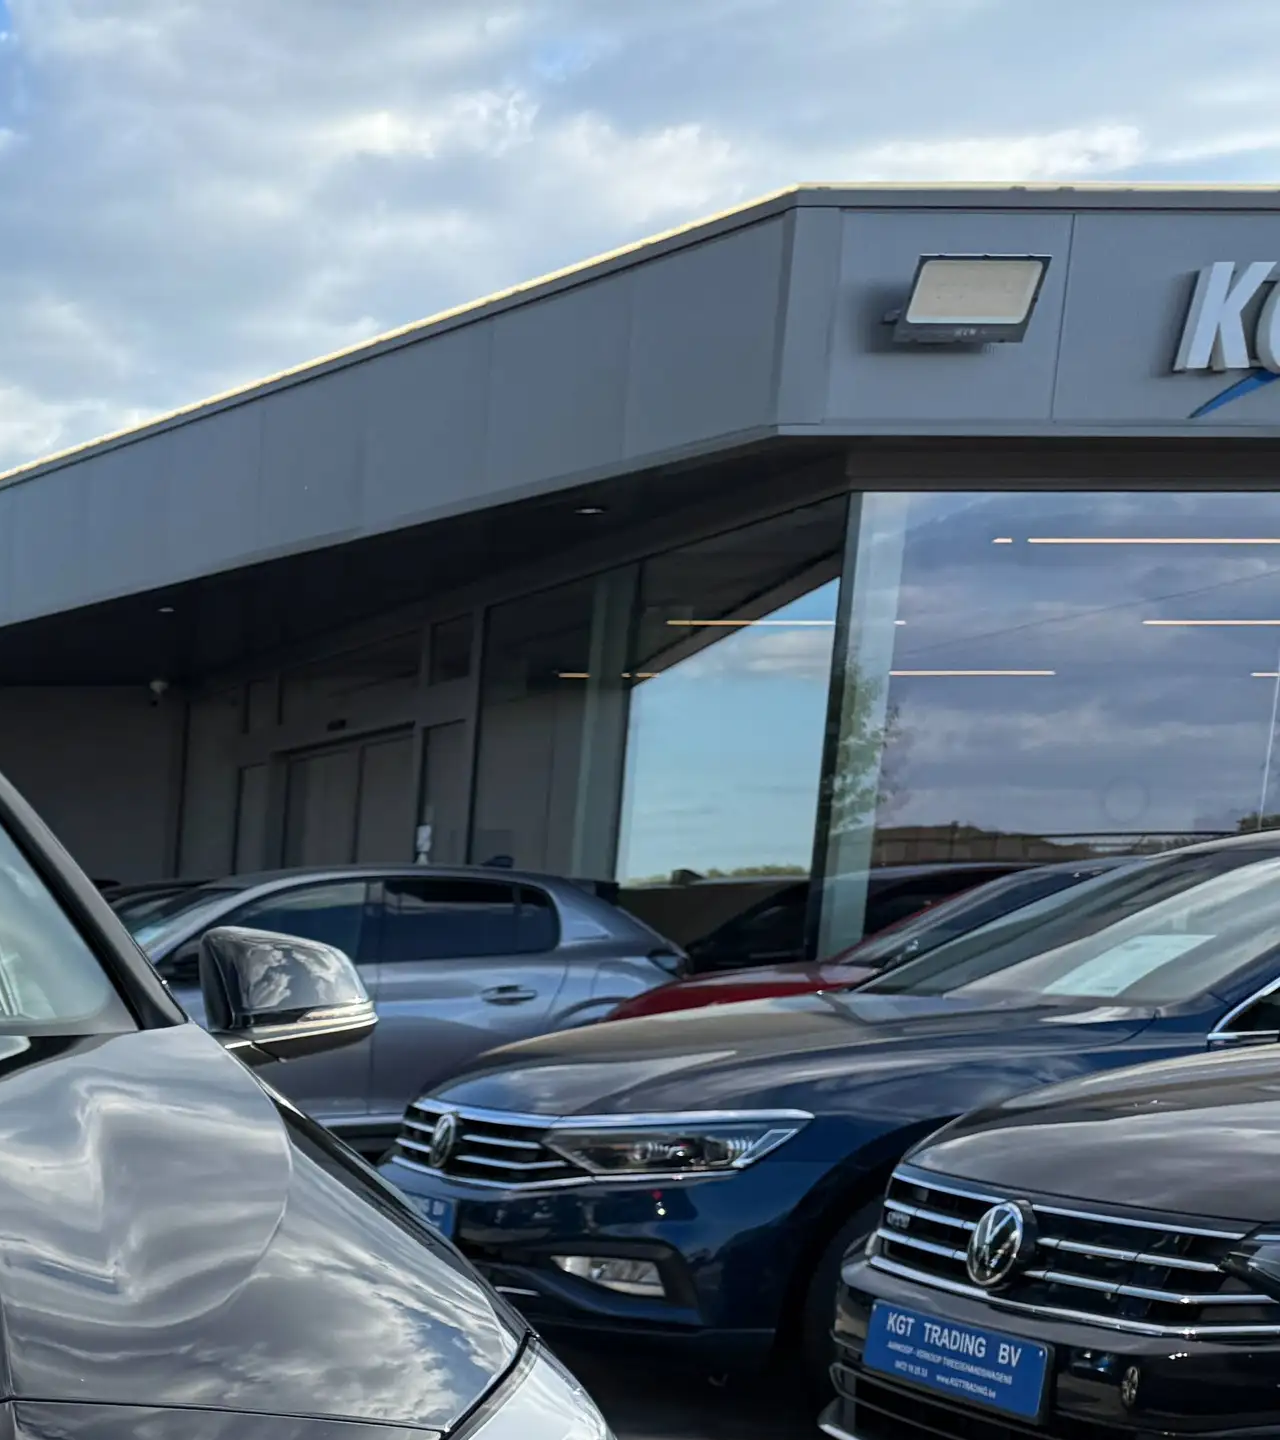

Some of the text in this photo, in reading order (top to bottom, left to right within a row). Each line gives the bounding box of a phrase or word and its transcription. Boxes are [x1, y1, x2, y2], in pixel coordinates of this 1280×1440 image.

[1173, 261, 1280, 374] K
[886, 1311, 916, 1338] KGT
[923, 1321, 987, 1358] TRADING
[997, 1342, 1022, 1368] BV
